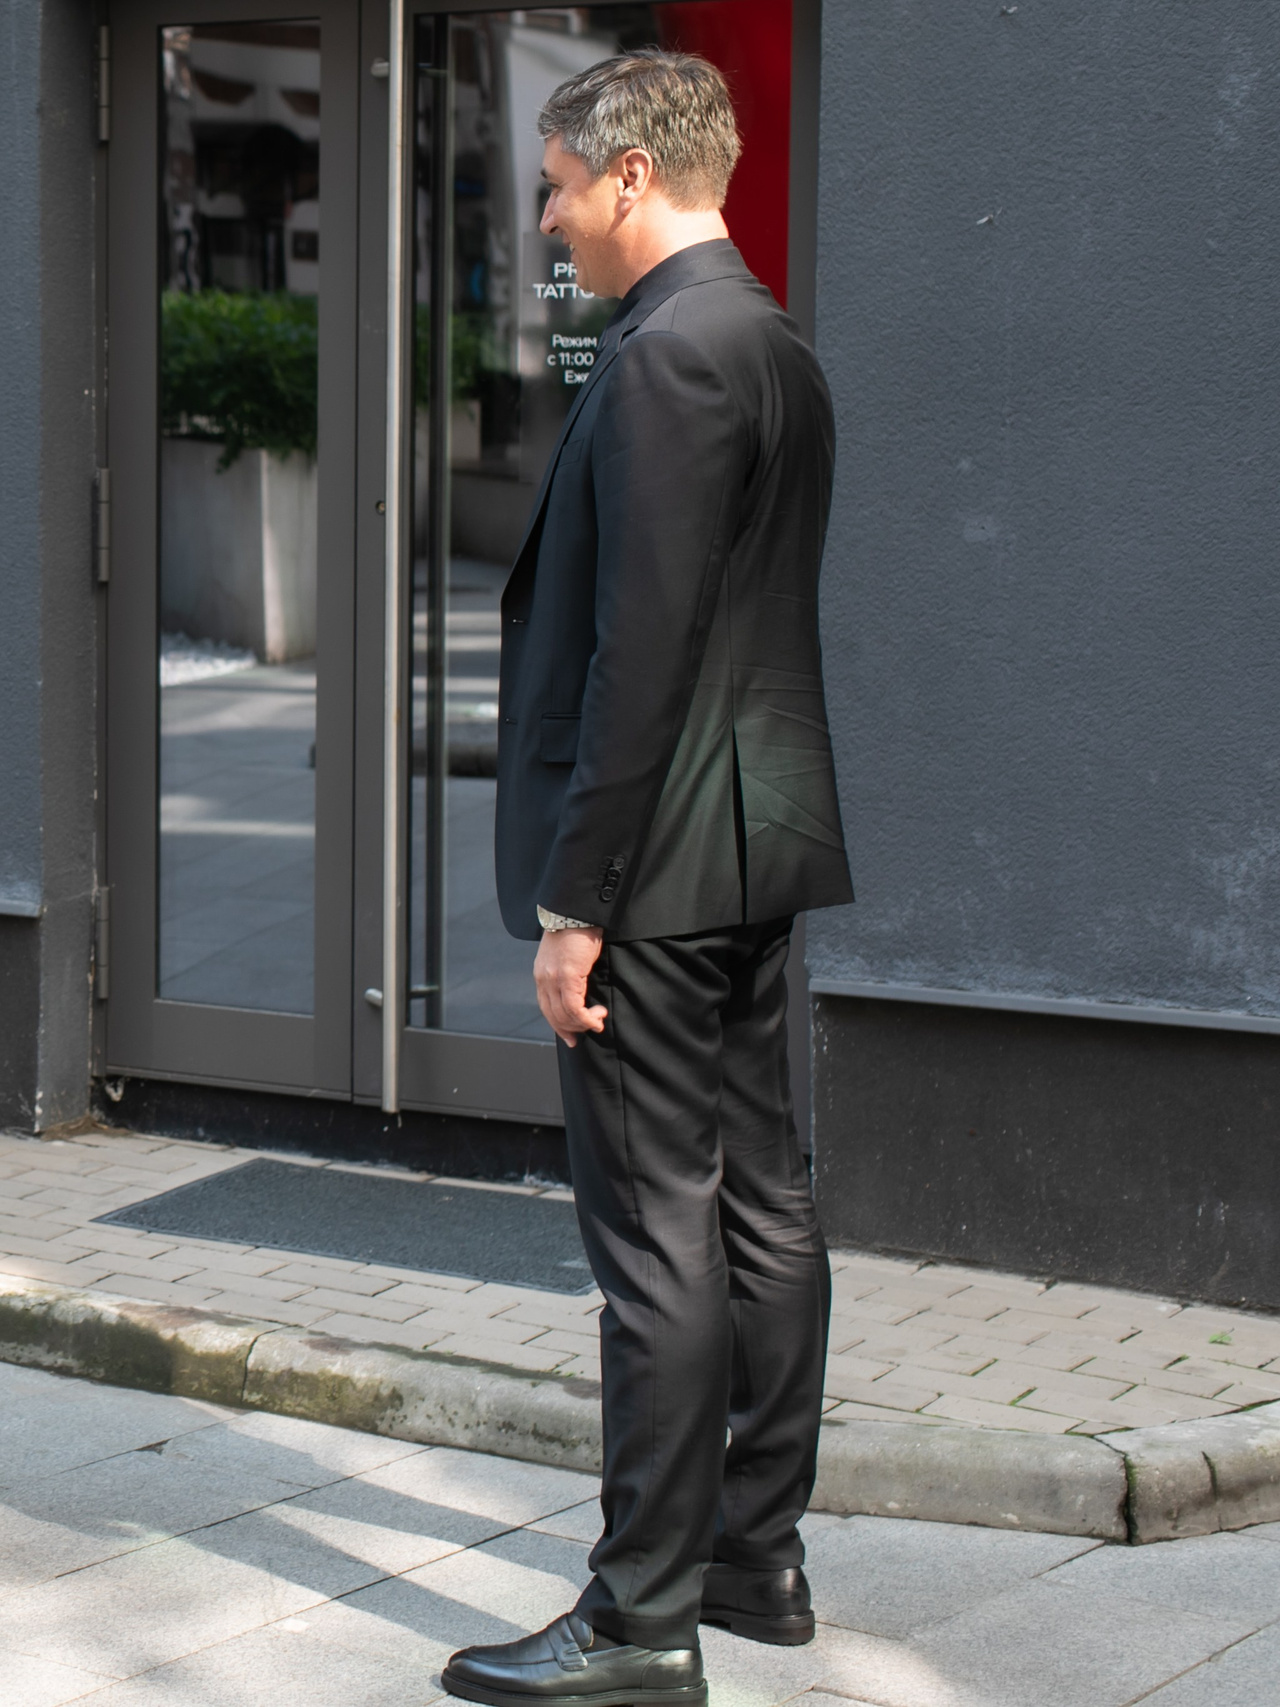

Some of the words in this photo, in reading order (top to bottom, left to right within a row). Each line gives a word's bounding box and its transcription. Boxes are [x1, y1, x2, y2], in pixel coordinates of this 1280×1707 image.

[554, 262, 578, 278] PR
[552, 334, 598, 348] Режим
[559, 352, 595, 366] 11:00
